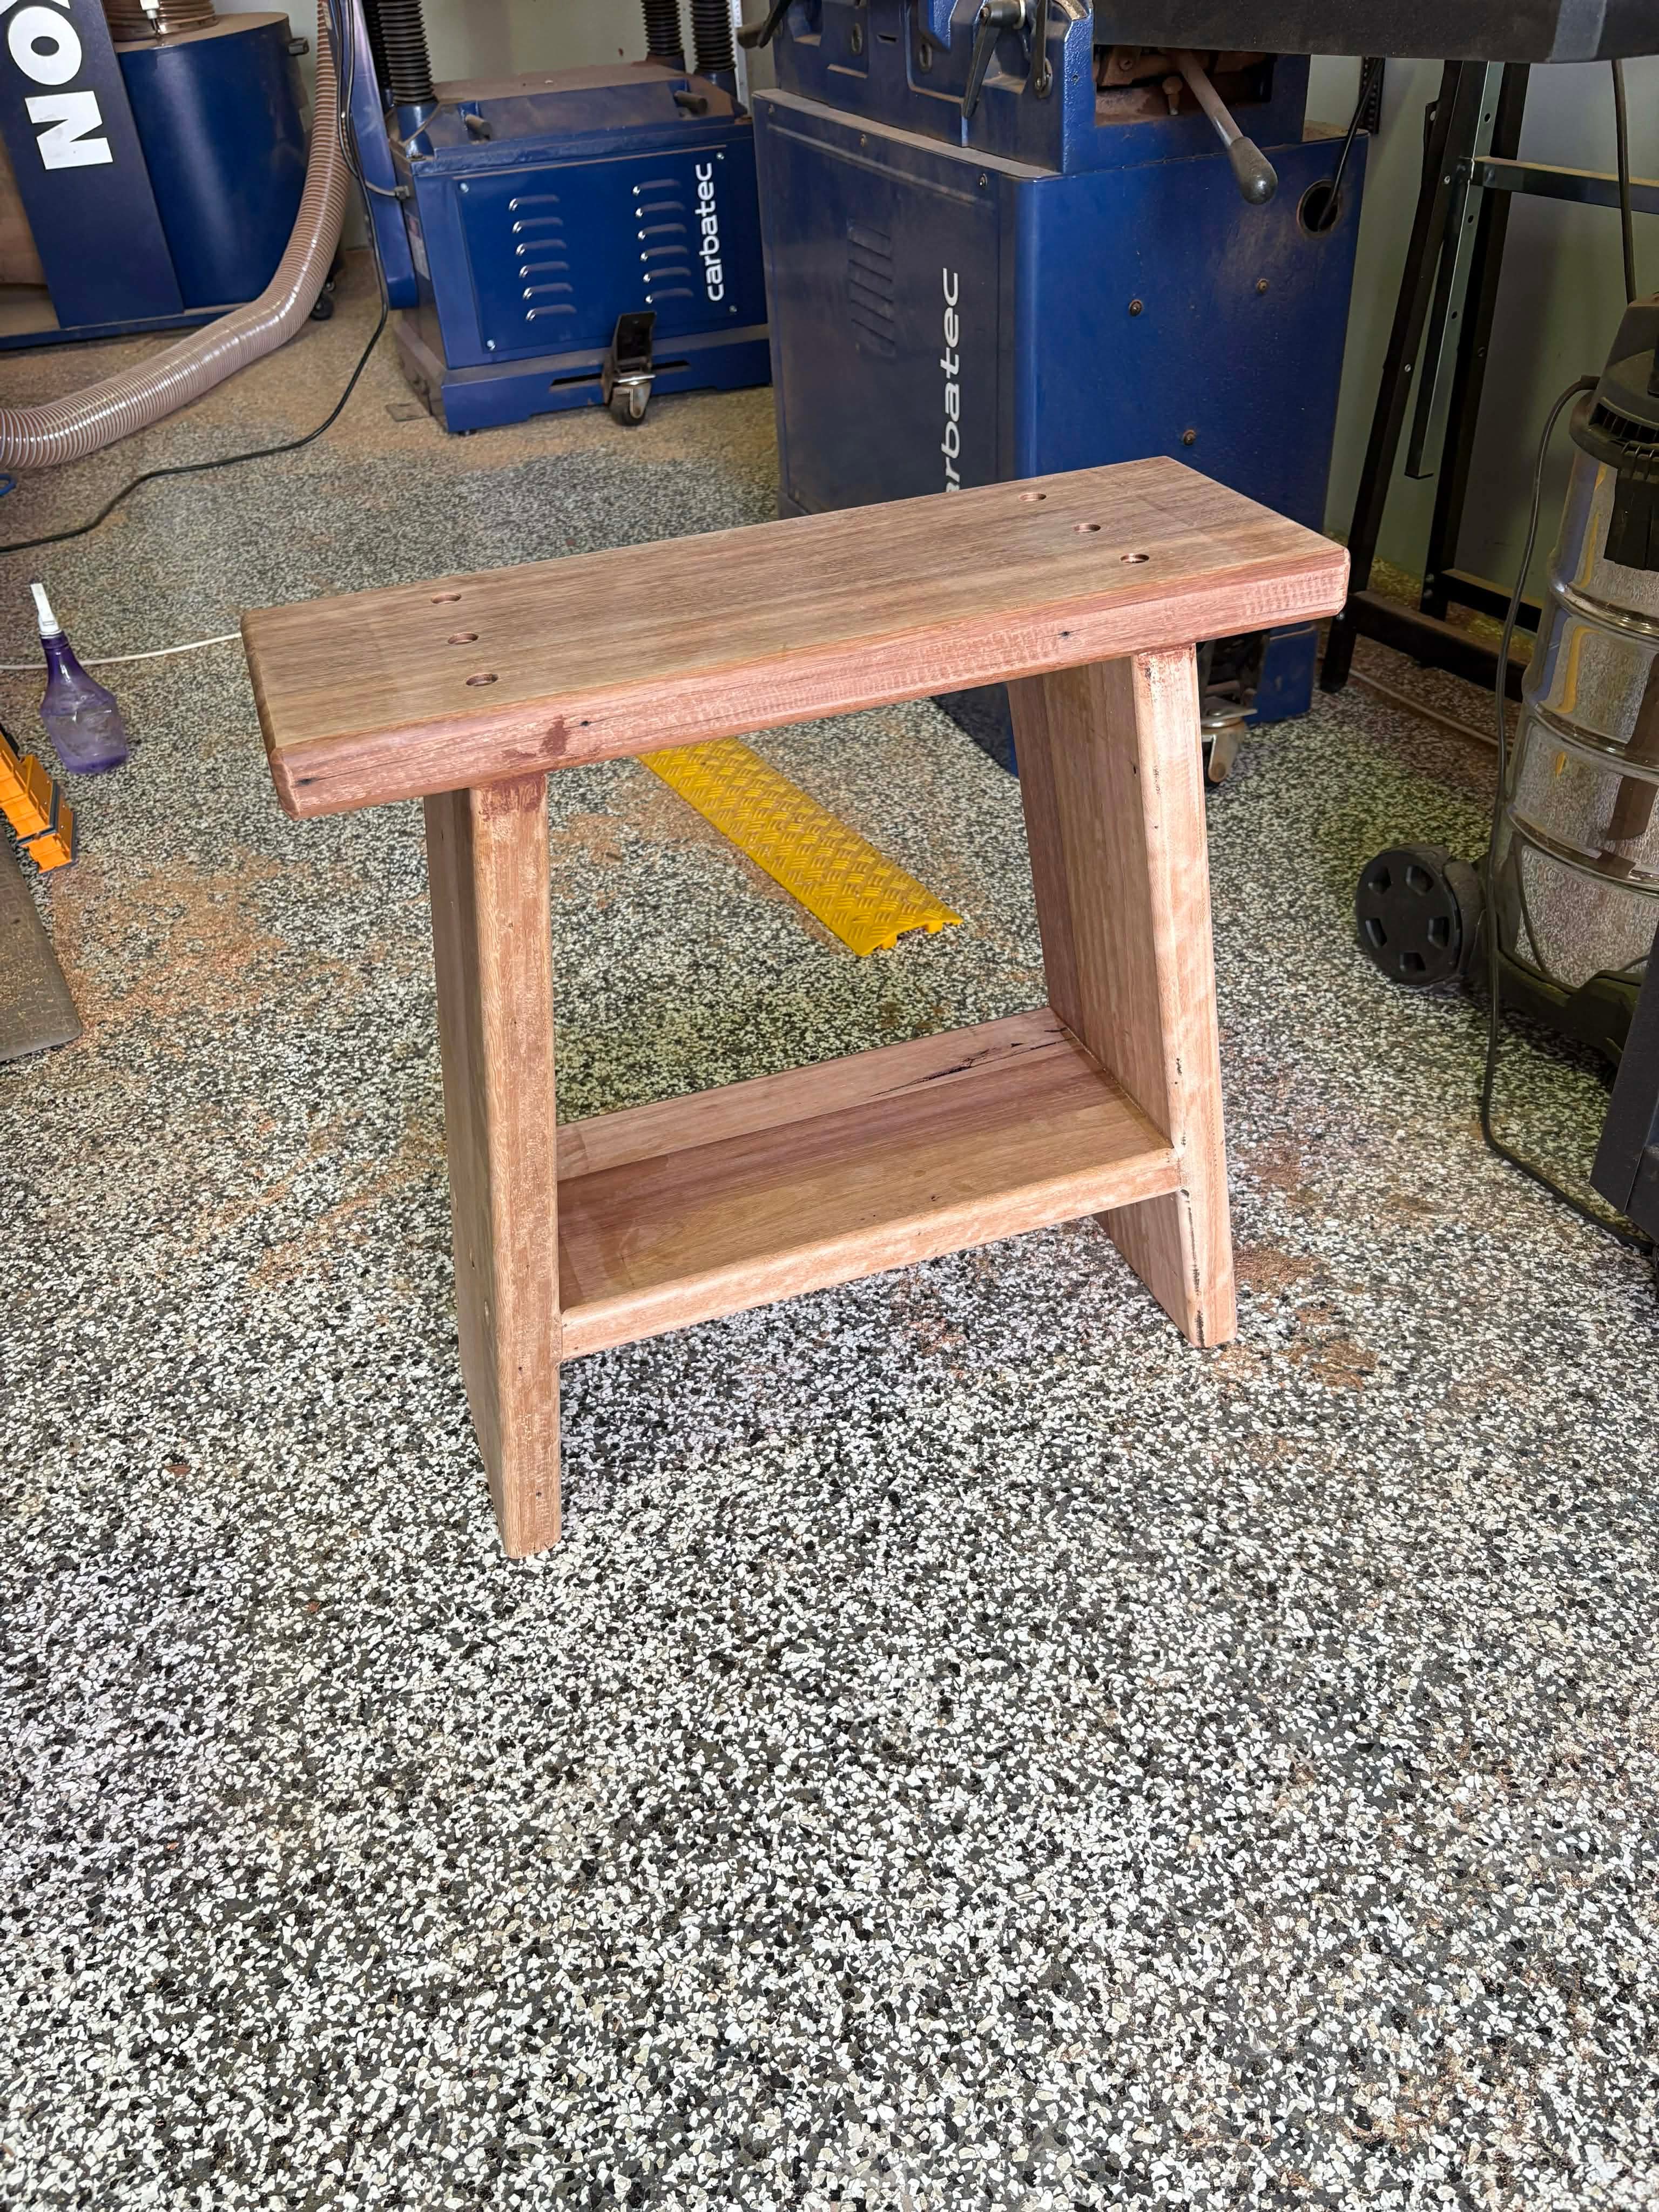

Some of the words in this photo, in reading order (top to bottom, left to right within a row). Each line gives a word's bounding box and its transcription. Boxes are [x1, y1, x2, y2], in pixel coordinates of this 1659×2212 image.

[0, 0, 113, 170] NO
[694, 163, 724, 301] carbatec
[940, 267, 960, 493] rbatec
